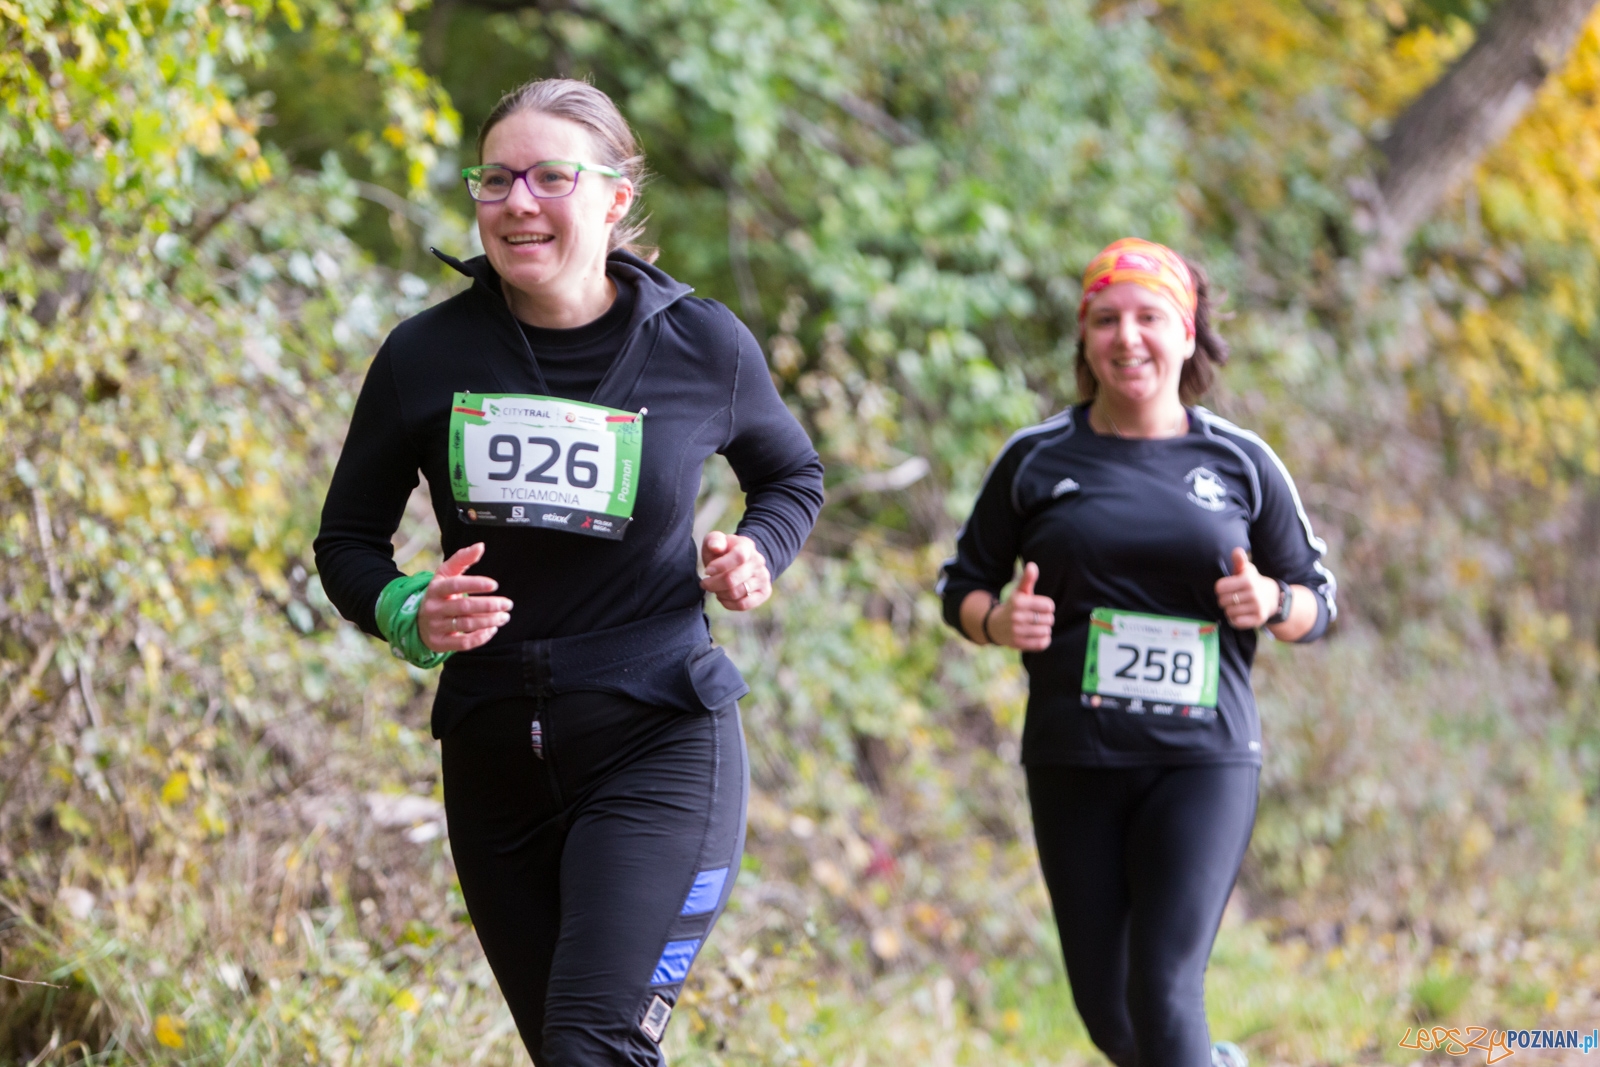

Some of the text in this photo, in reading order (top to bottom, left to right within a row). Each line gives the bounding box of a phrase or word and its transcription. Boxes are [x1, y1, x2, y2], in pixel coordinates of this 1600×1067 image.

[487, 434, 599, 489] 926
[617, 458, 633, 503] Poznań
[500, 487, 580, 506] TYCIAMONIA
[1114, 643, 1193, 685] 258
